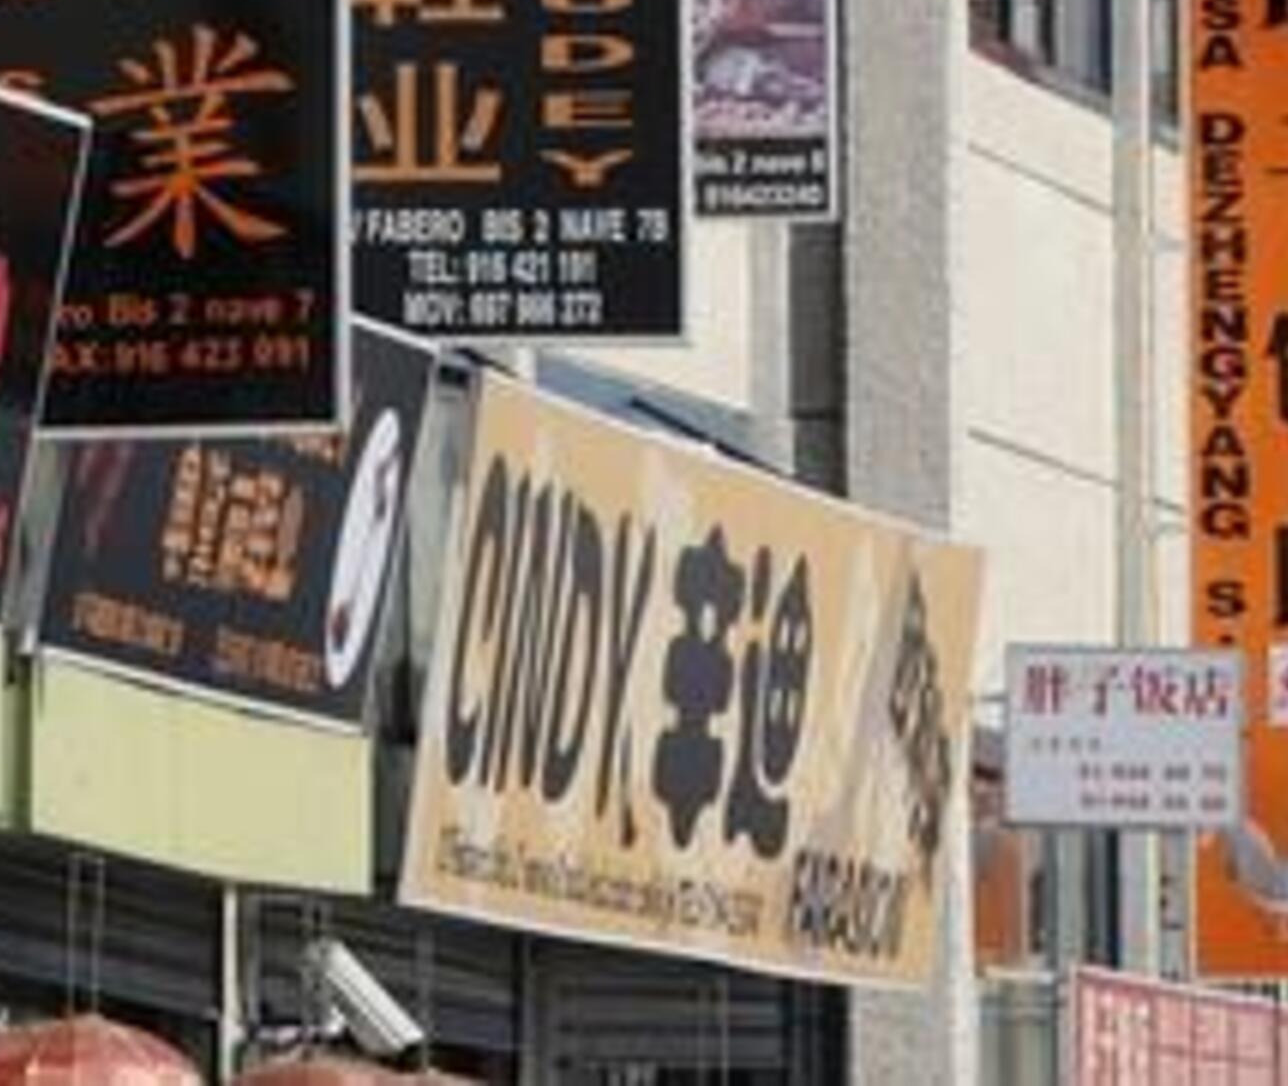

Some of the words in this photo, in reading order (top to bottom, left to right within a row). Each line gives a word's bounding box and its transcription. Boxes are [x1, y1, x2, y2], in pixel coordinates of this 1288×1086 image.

[480, 209, 524, 243] BIS
[533, 209, 550, 243] 2
[558, 208, 625, 243] NAVE
[407, 250, 459, 284] TEL:
[402, 291, 462, 325] MOV:
[1198, 113, 1252, 539] DEZHENGYANG
